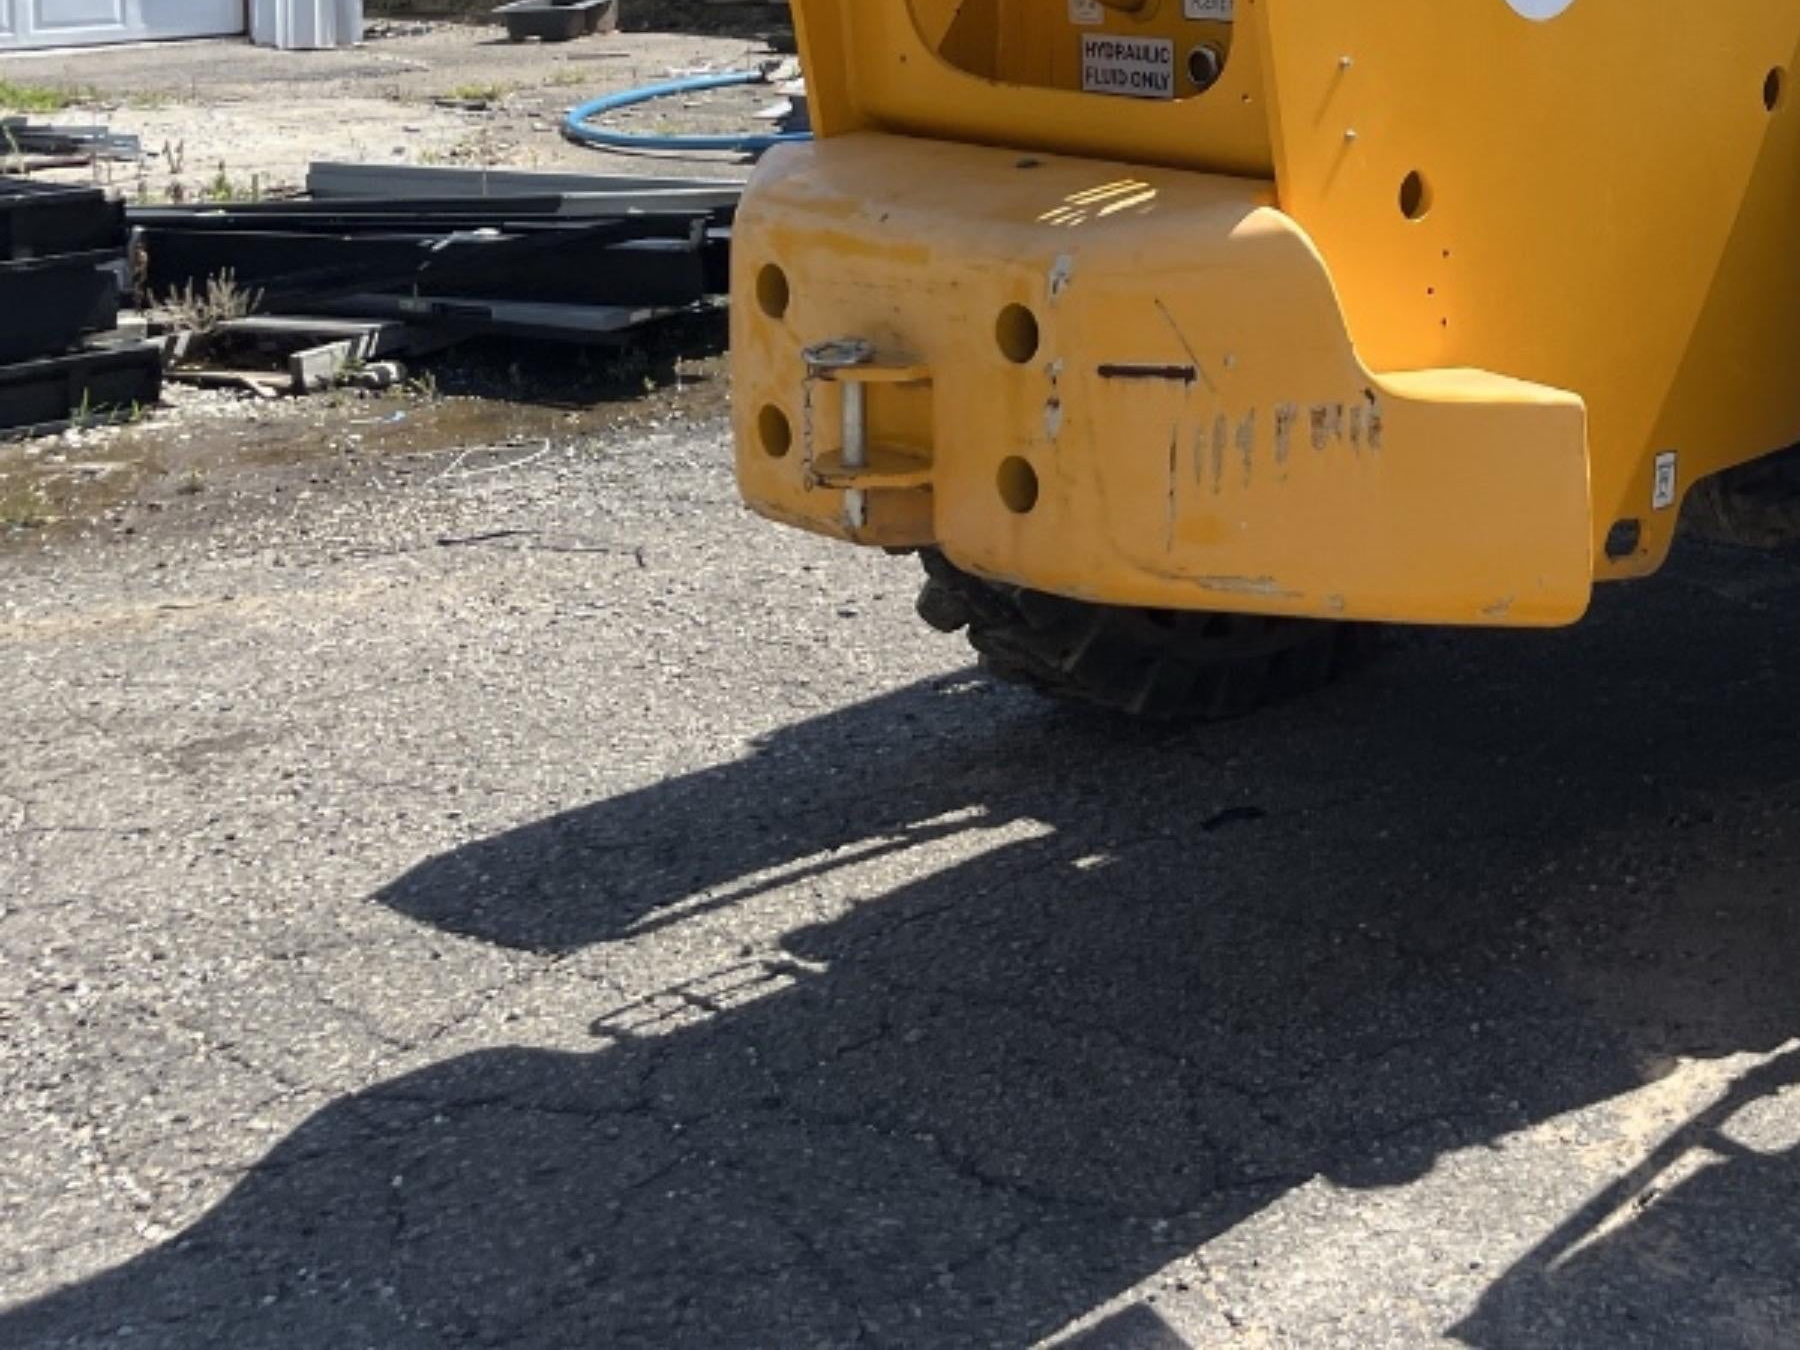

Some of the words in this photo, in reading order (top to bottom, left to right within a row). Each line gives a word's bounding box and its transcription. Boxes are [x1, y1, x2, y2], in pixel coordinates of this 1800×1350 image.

[1085, 40, 1171, 64] HYDRAULIC
[1085, 65, 1128, 86] FLUID
[1131, 70, 1171, 91] ONLY
